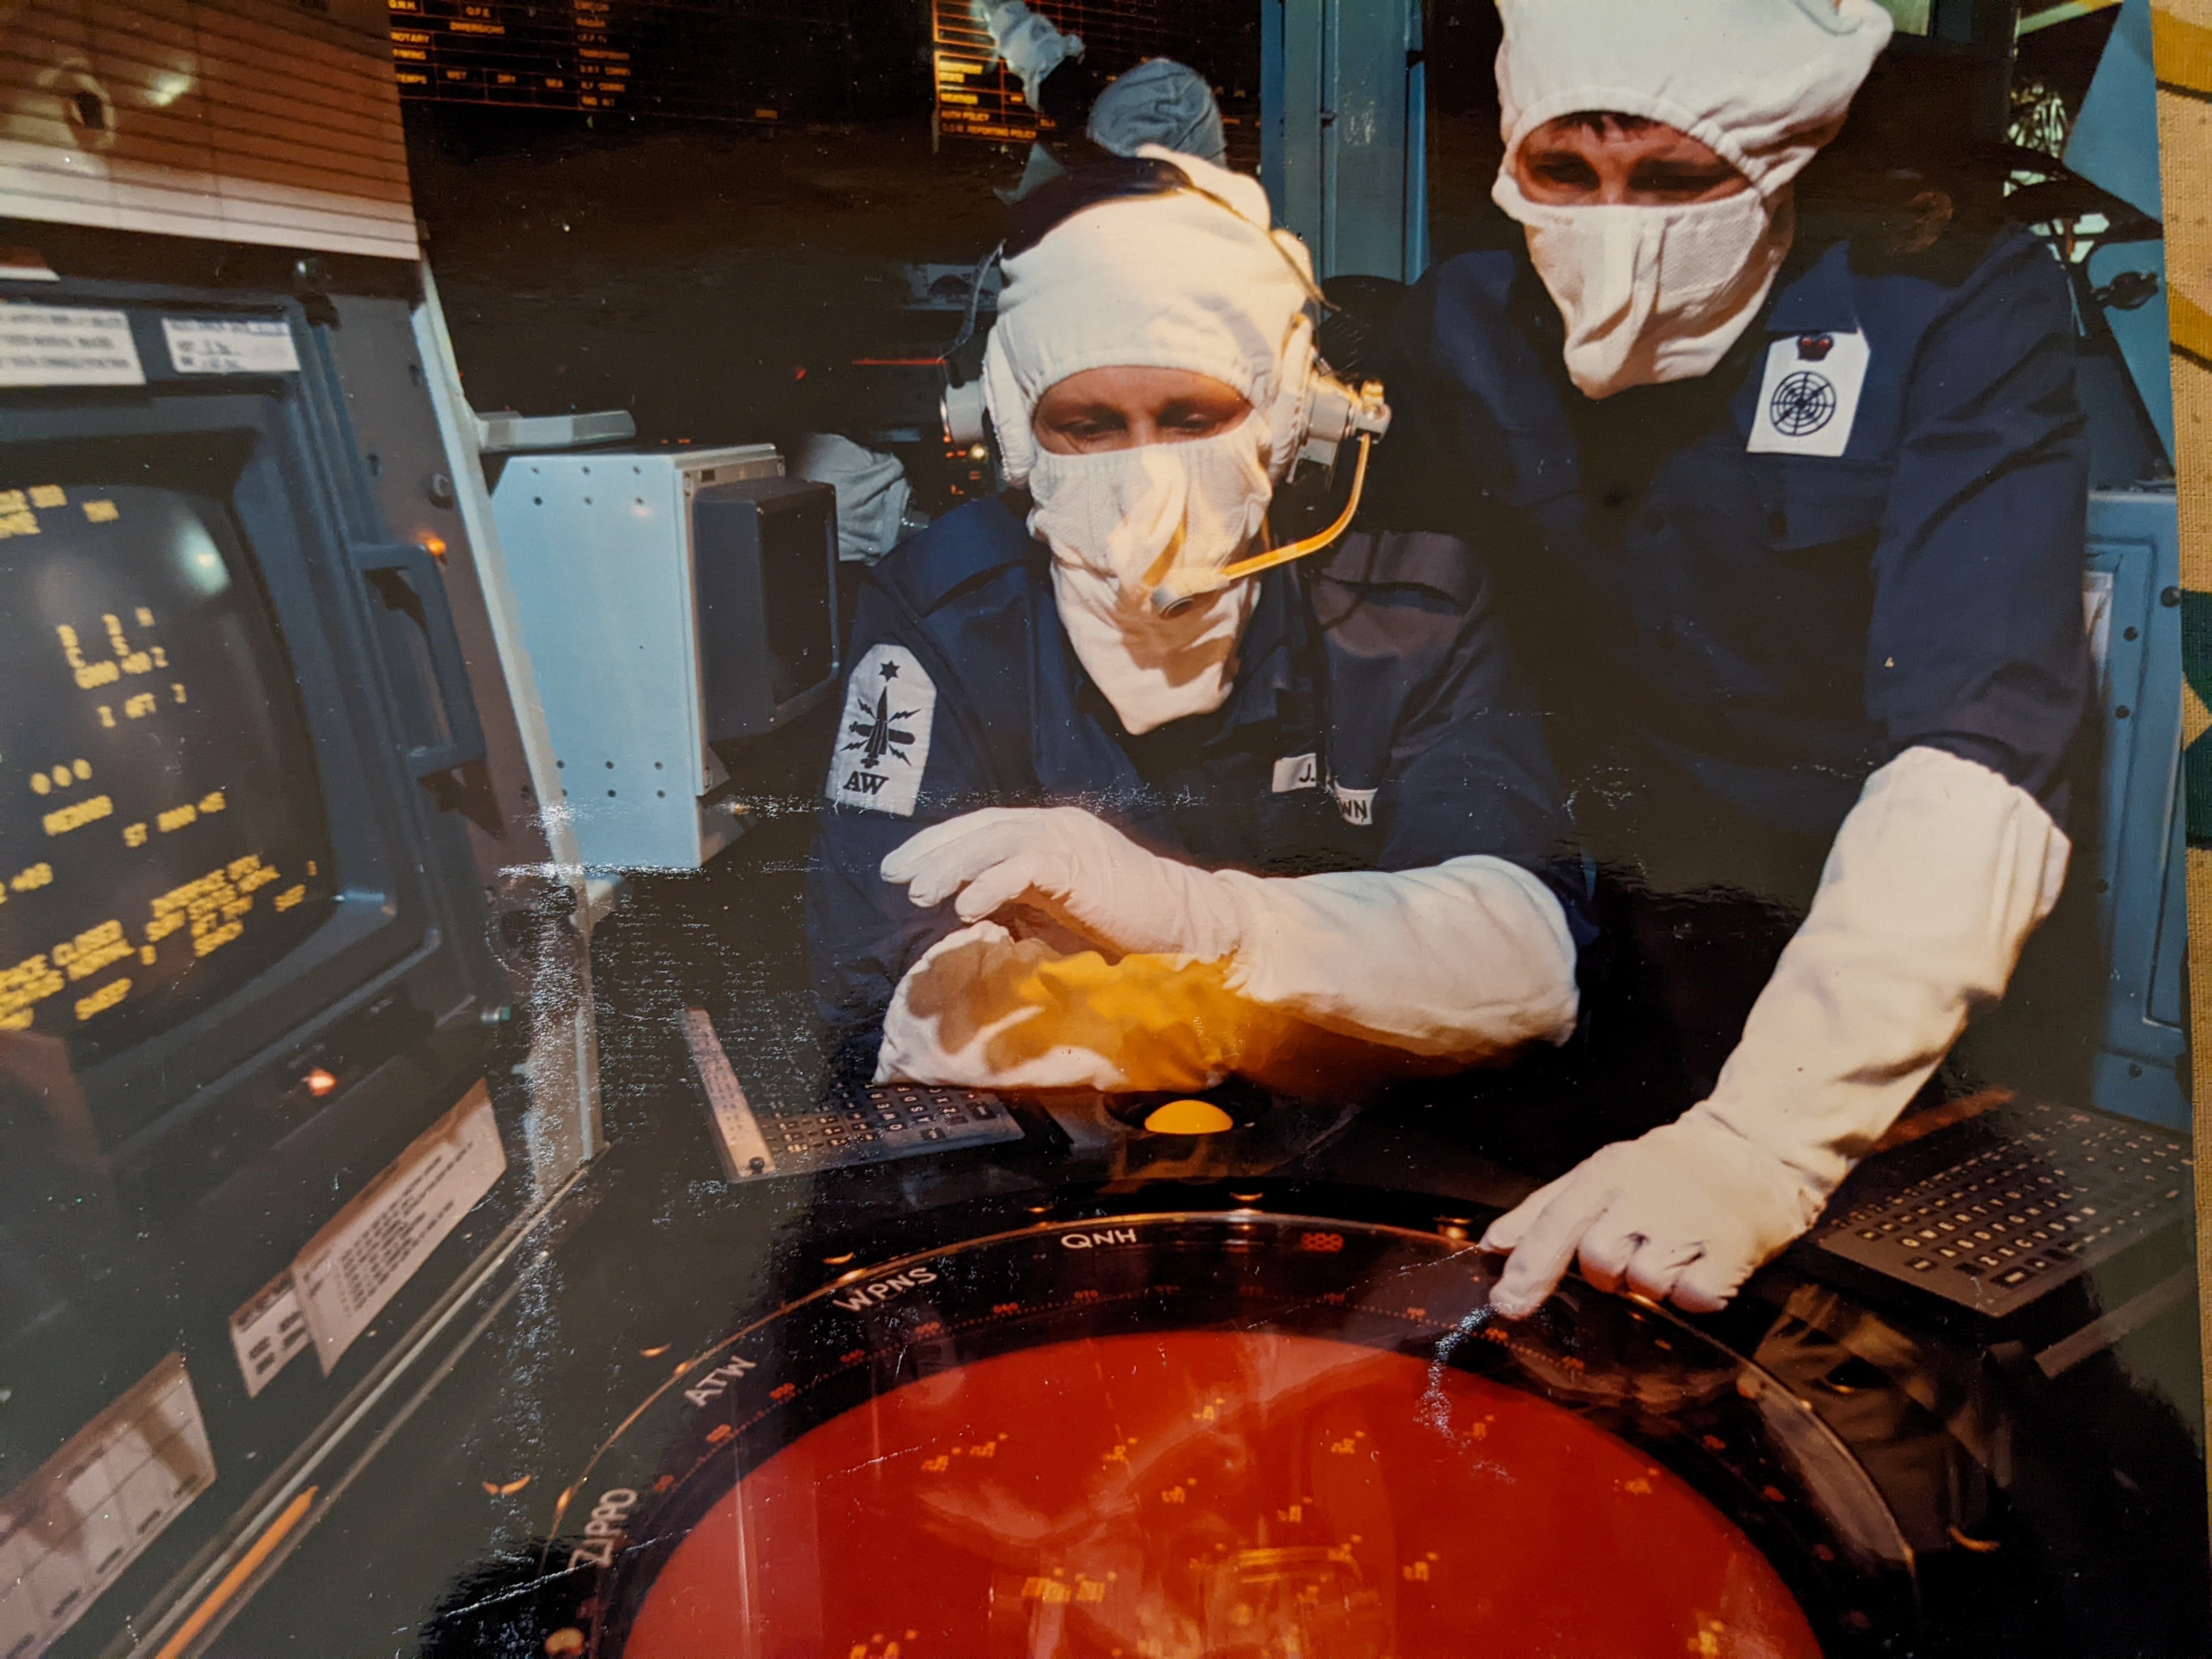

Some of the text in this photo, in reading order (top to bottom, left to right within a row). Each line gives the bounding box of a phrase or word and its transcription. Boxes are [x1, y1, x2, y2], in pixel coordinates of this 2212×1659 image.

[843, 770, 889, 795] AW
[1299, 763, 1317, 783] J.
[1059, 1228, 1138, 1250] QNH
[832, 1266, 938, 1313] WPNS
[684, 1355, 757, 1408] ATW
[567, 1487, 638, 1570] ZIPPO
